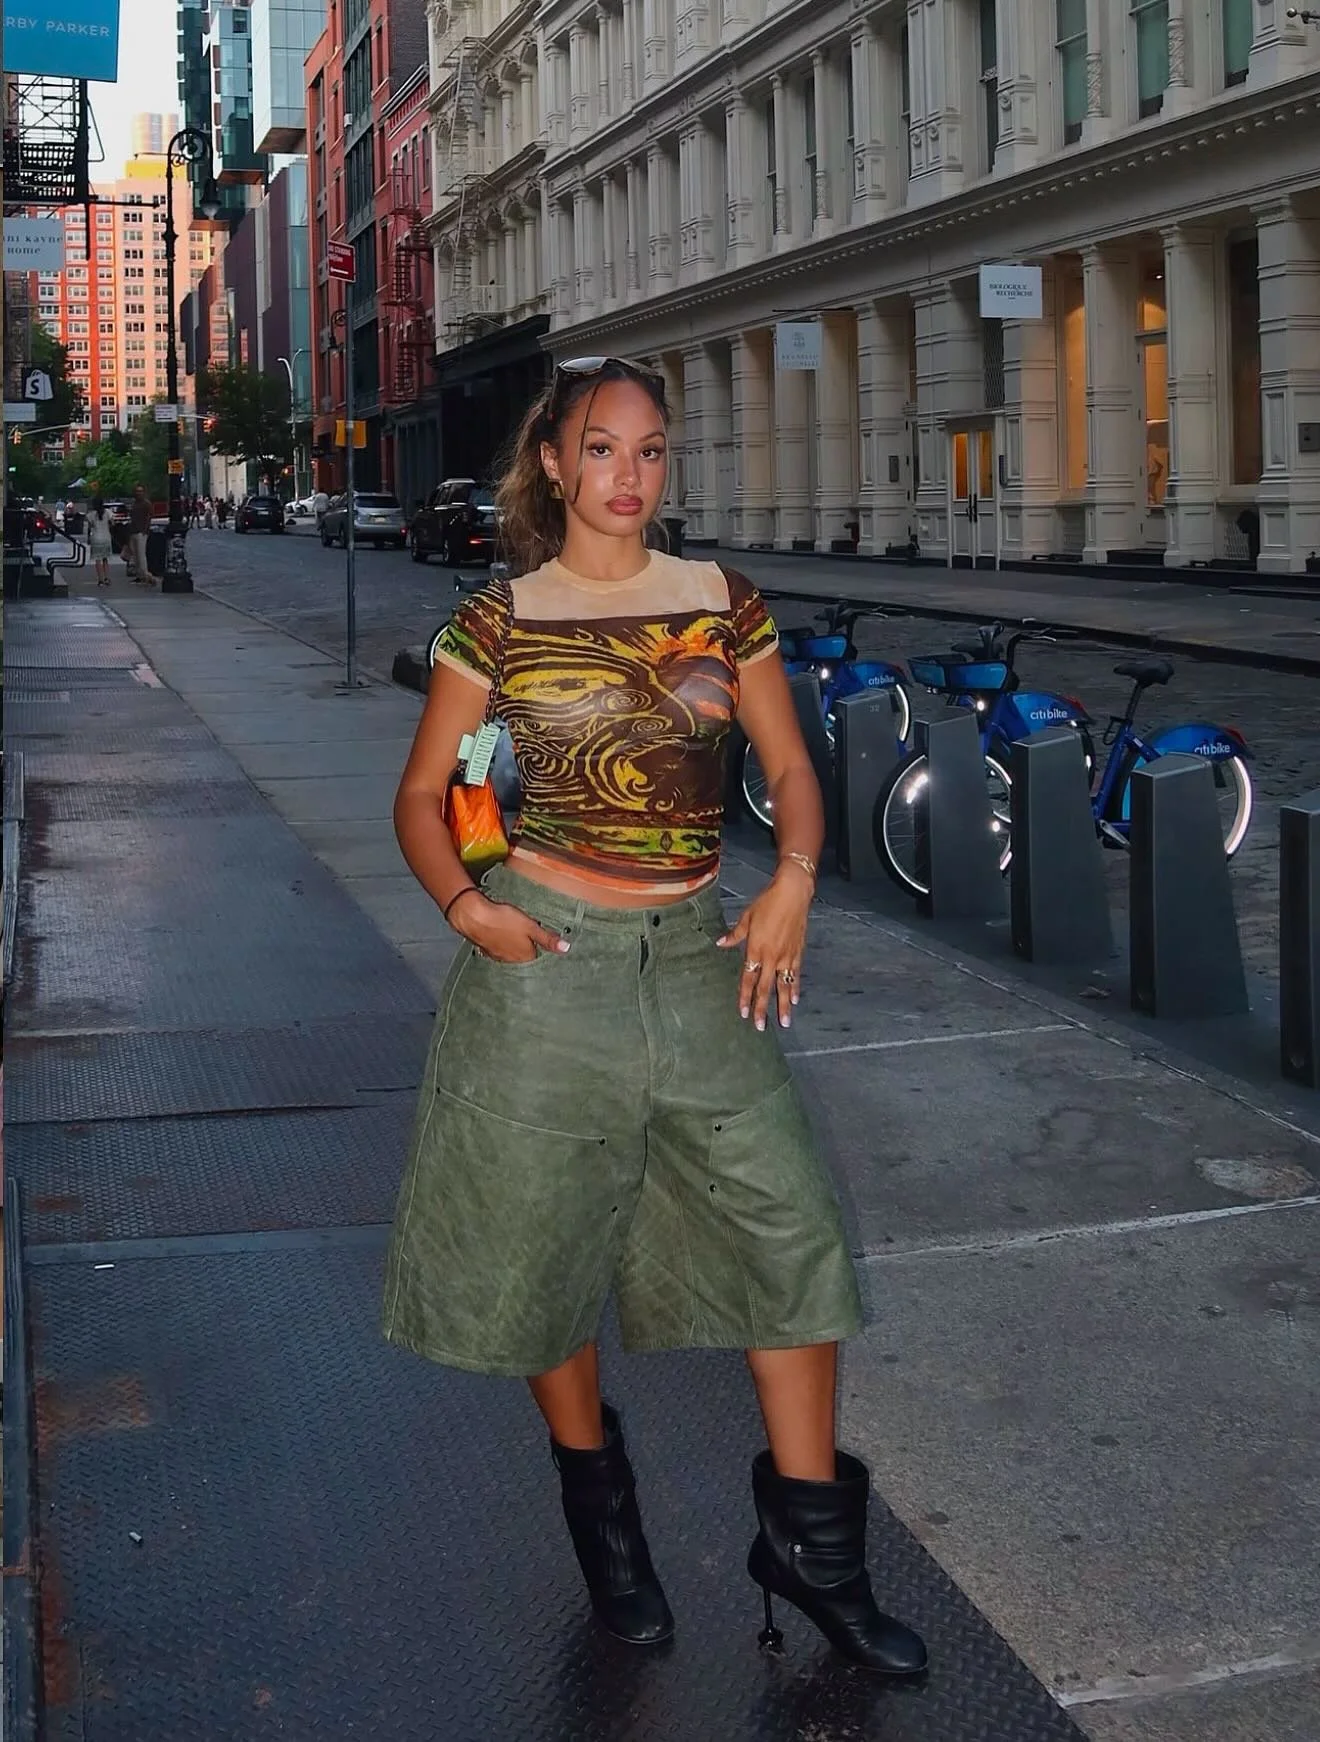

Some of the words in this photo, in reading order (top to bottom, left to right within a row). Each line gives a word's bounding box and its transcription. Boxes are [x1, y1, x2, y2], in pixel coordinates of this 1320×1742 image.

[3, 16, 38, 29] RBY
[46, 20, 110, 37] PARKER
[30, 379, 40, 395] S
